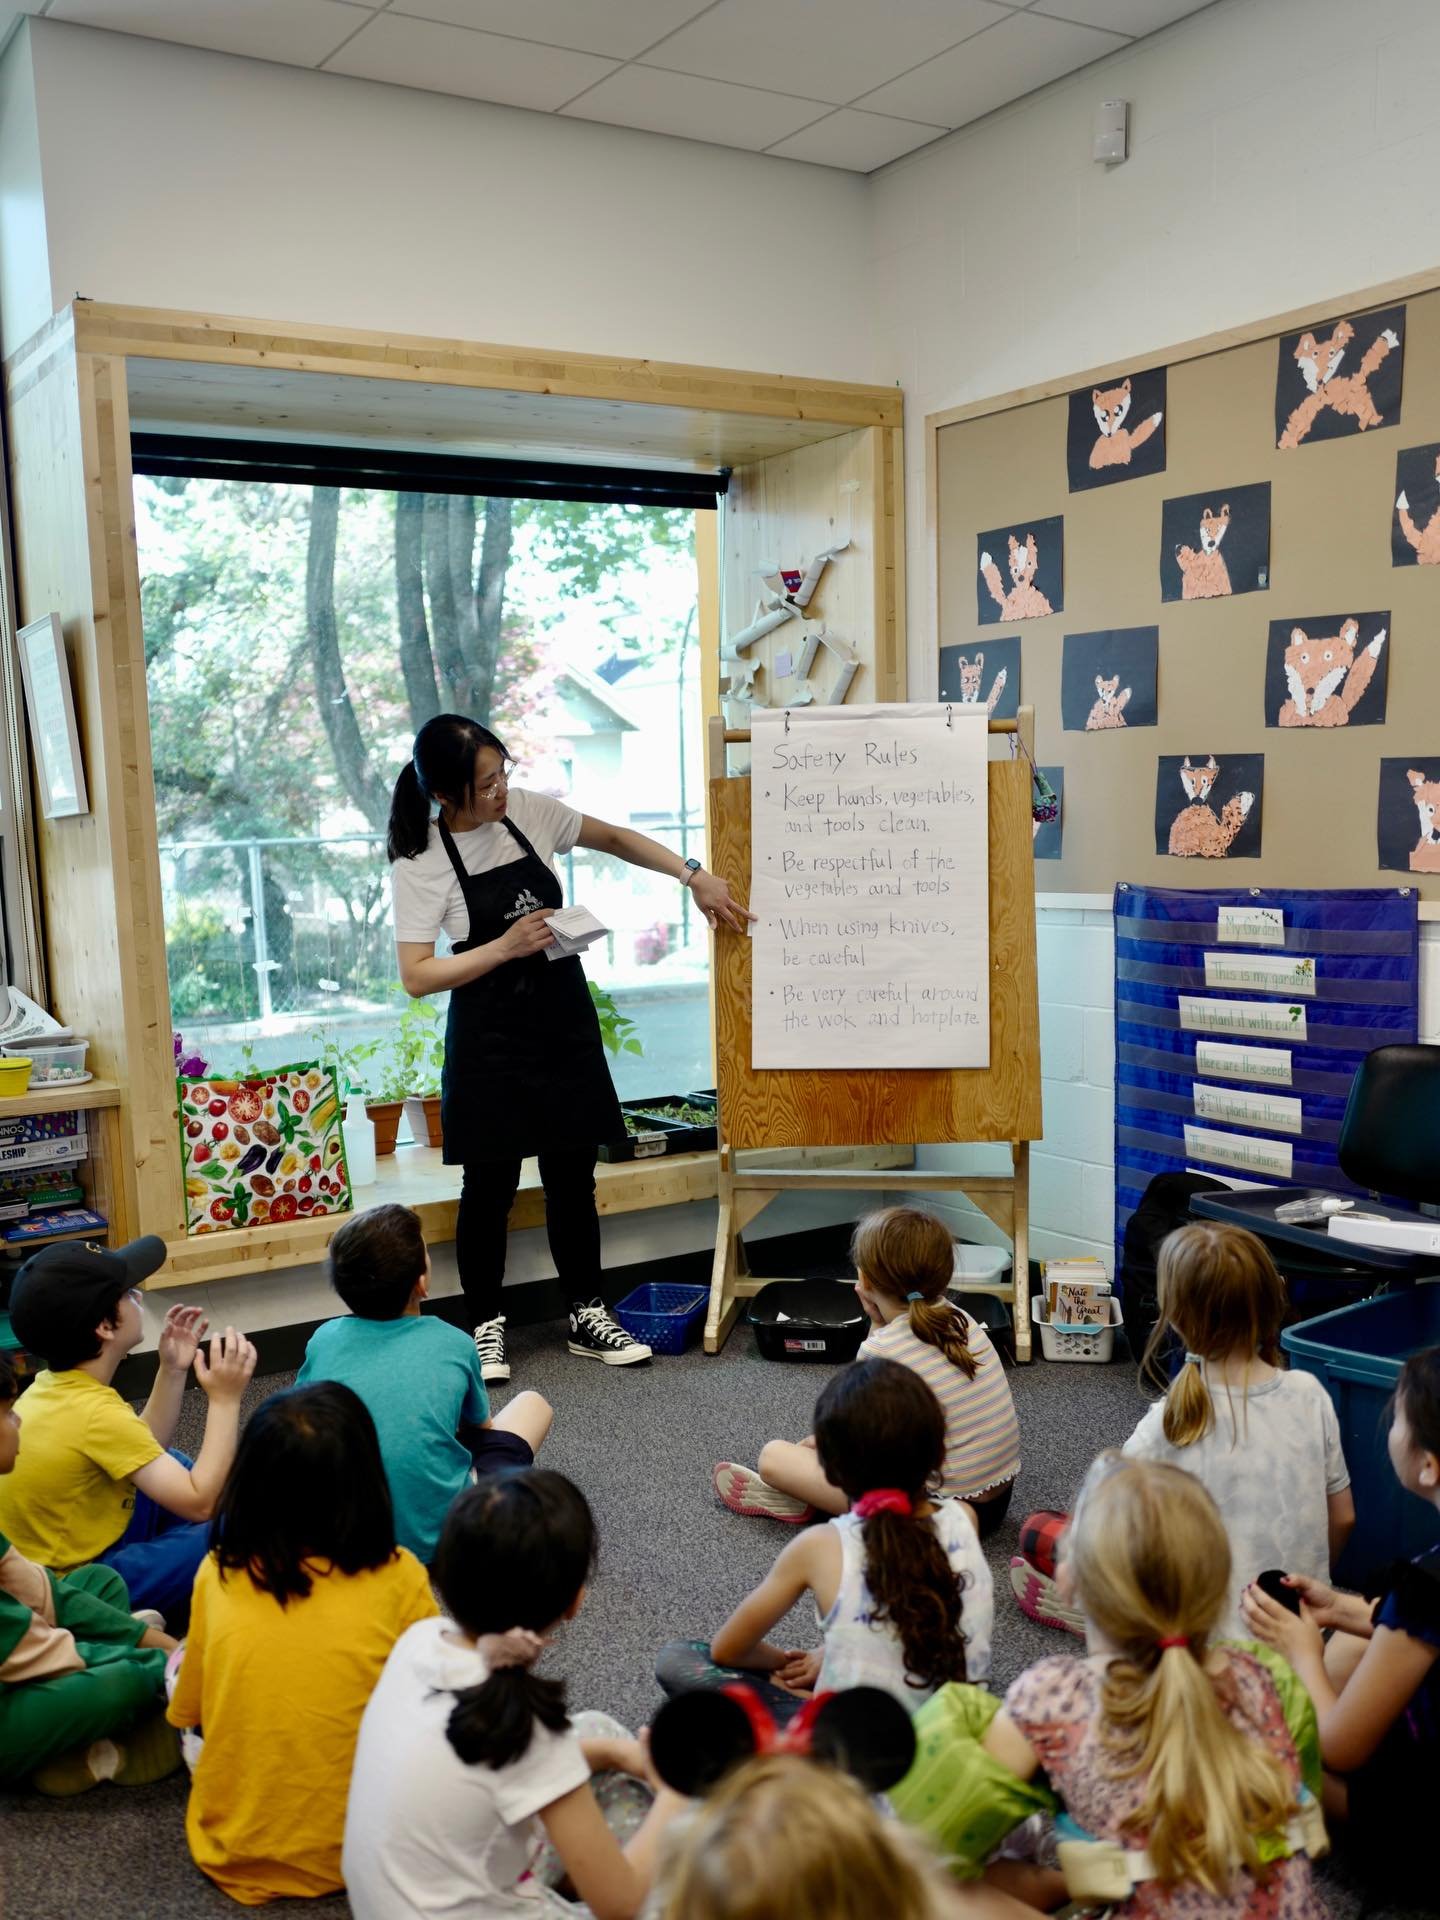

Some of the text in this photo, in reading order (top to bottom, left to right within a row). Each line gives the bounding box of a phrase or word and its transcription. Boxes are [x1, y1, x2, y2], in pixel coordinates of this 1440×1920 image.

[772, 740, 918, 775] Safety Rules
[784, 781, 975, 812] Keep hands, vegetables,
[785, 811, 930, 836] and tools clean.
[782, 848, 956, 878] Be respectful of the
[785, 875, 950, 899] vegetables and tools
[780, 912, 956, 940] When using knives,
[783, 946, 801, 966] be
[783, 982, 978, 1006] Be very careful around
[783, 1009, 809, 1032] the
[818, 1007, 857, 1030] wok
[868, 1006, 899, 1026] and
[1248, 1010, 1273, 1030] with
[1067, 1287, 1088, 1297] Nate
